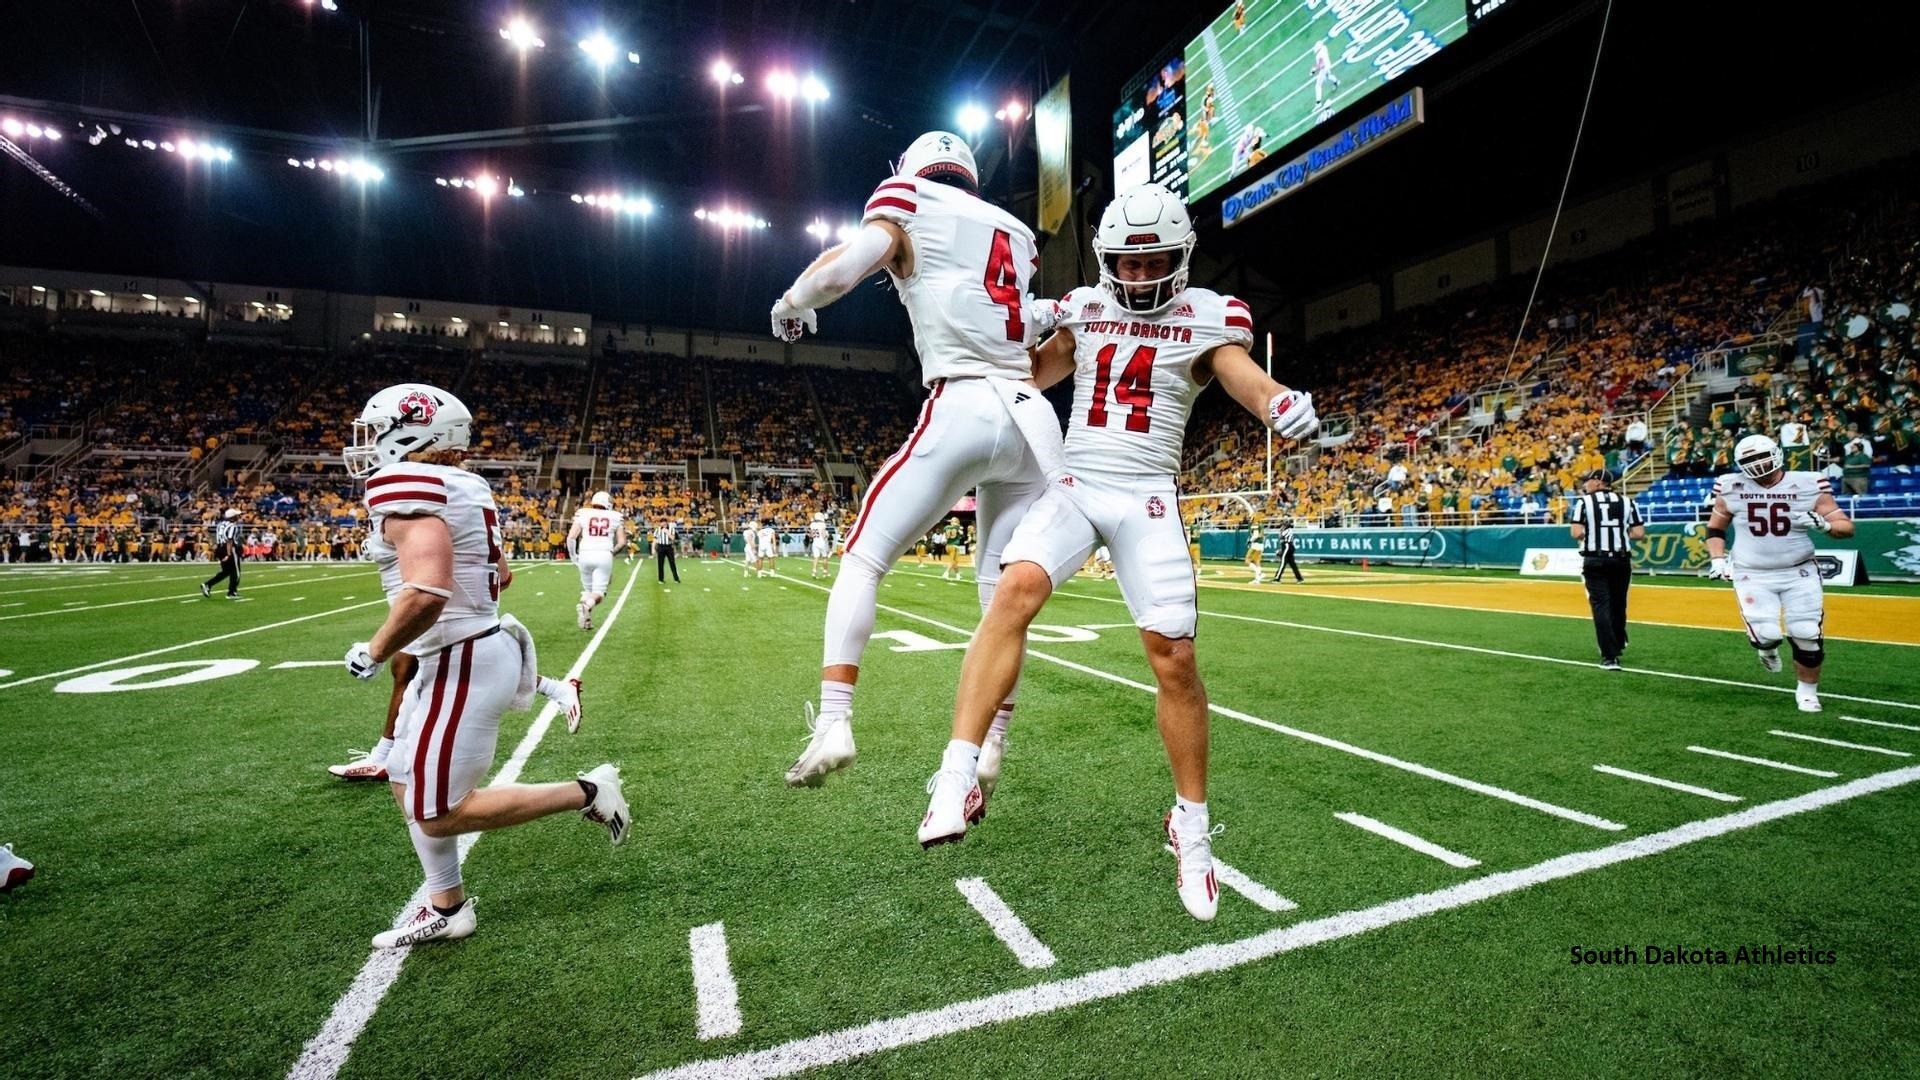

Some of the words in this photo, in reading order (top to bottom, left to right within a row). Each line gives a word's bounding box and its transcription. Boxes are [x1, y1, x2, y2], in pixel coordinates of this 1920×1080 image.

[1275, 159, 1309, 189] City
[1307, 130, 1357, 172] Bank
[1357, 95, 1414, 144] Field
[1129, 235, 1156, 243] YOTES
[984, 228, 1026, 342] 4
[1084, 320, 1128, 335] SOUTH
[1129, 321, 1193, 344] DAKOTA
[1087, 343, 1158, 433] 14
[588, 517, 610, 537] 62
[1600, 503, 1619, 526] L
[1747, 502, 1791, 537] 56
[1293, 538, 1323, 550] CITY
[1330, 538, 1373, 550] BANK
[1379, 538, 1430, 551] FIELD
[395, 917, 448, 948] ADIZERO
